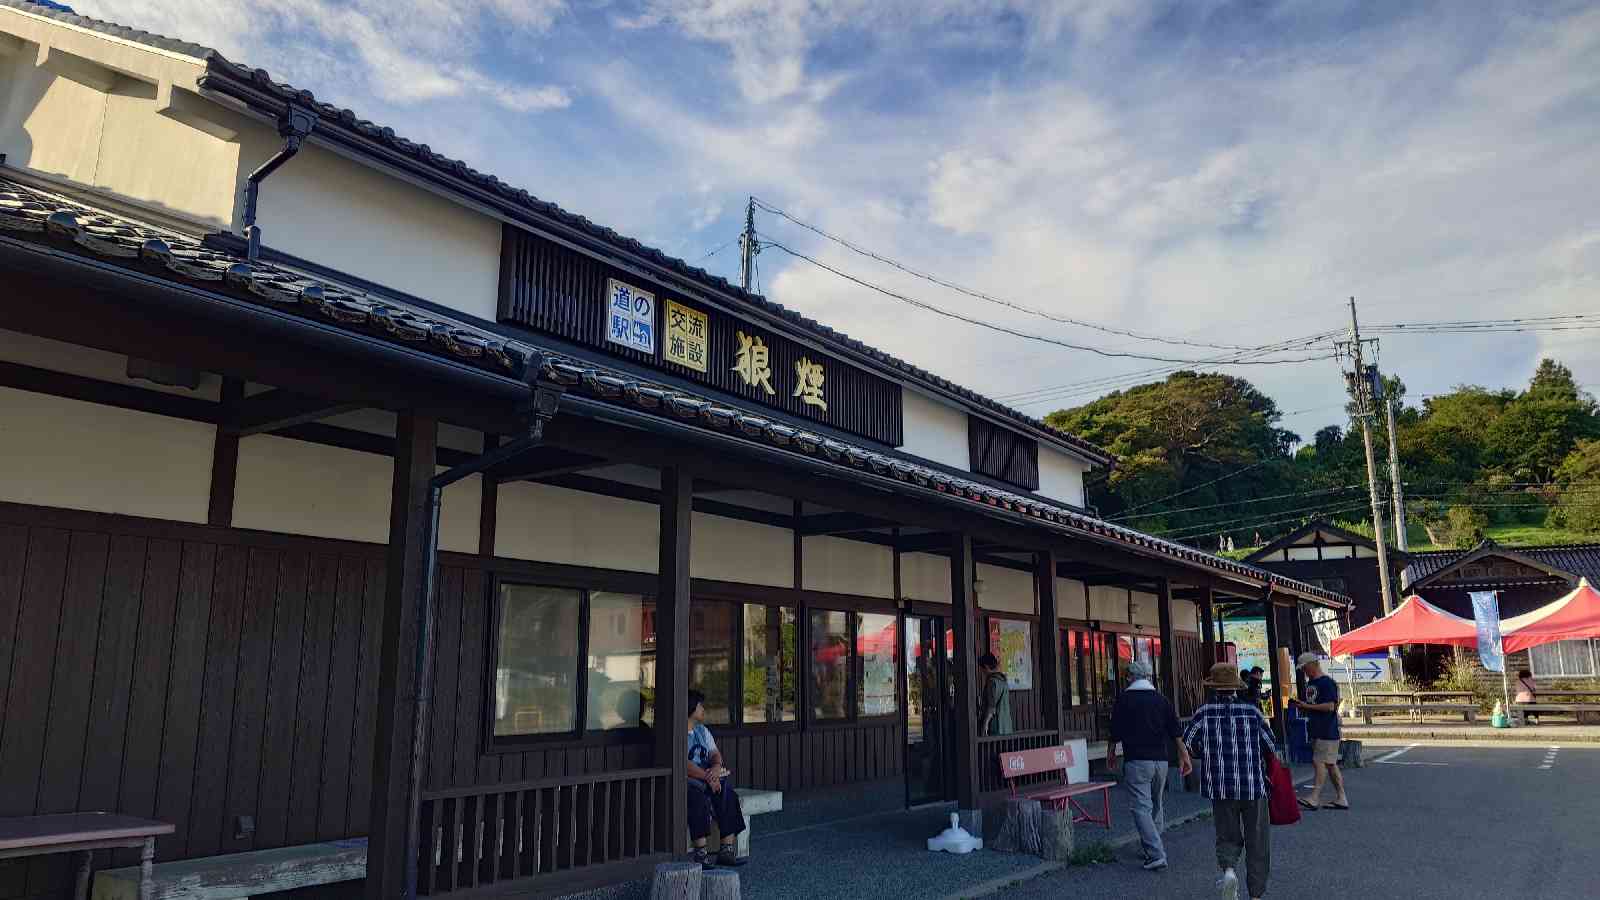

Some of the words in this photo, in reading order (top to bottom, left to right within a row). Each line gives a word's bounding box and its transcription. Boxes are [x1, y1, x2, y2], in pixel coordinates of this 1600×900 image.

[612, 285, 650, 316] 道の
[611, 314, 629, 341] 駅
[670, 310, 703, 339] 交流
[669, 334, 703, 364] 施設
[730, 330, 827, 412] 狼煙
